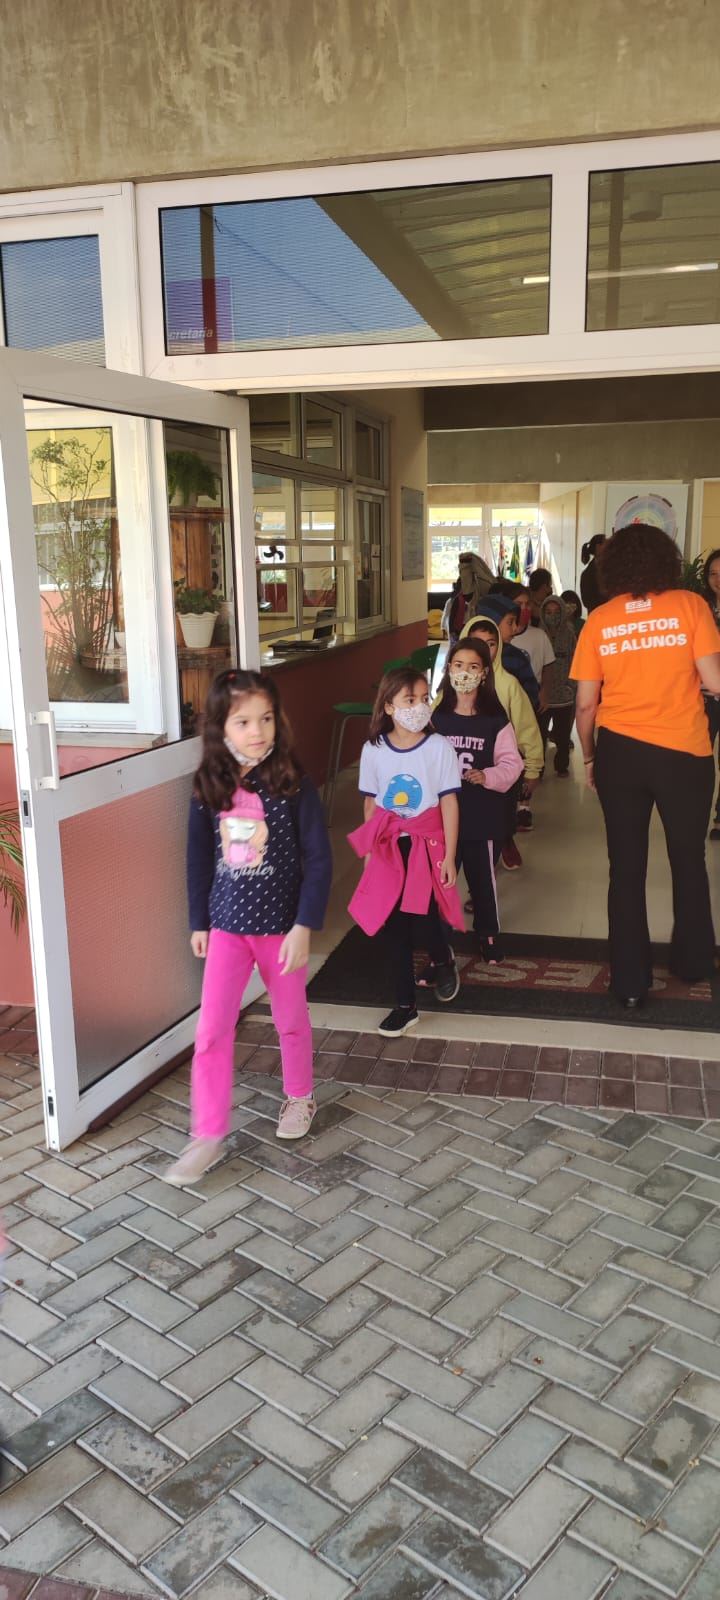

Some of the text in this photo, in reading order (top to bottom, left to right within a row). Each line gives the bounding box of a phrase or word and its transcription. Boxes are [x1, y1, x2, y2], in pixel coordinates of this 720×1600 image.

[602, 618, 680, 639] INSPETOR
[599, 634, 687, 656] DE ALUNOS
[446, 735, 485, 750] SOLUTE
